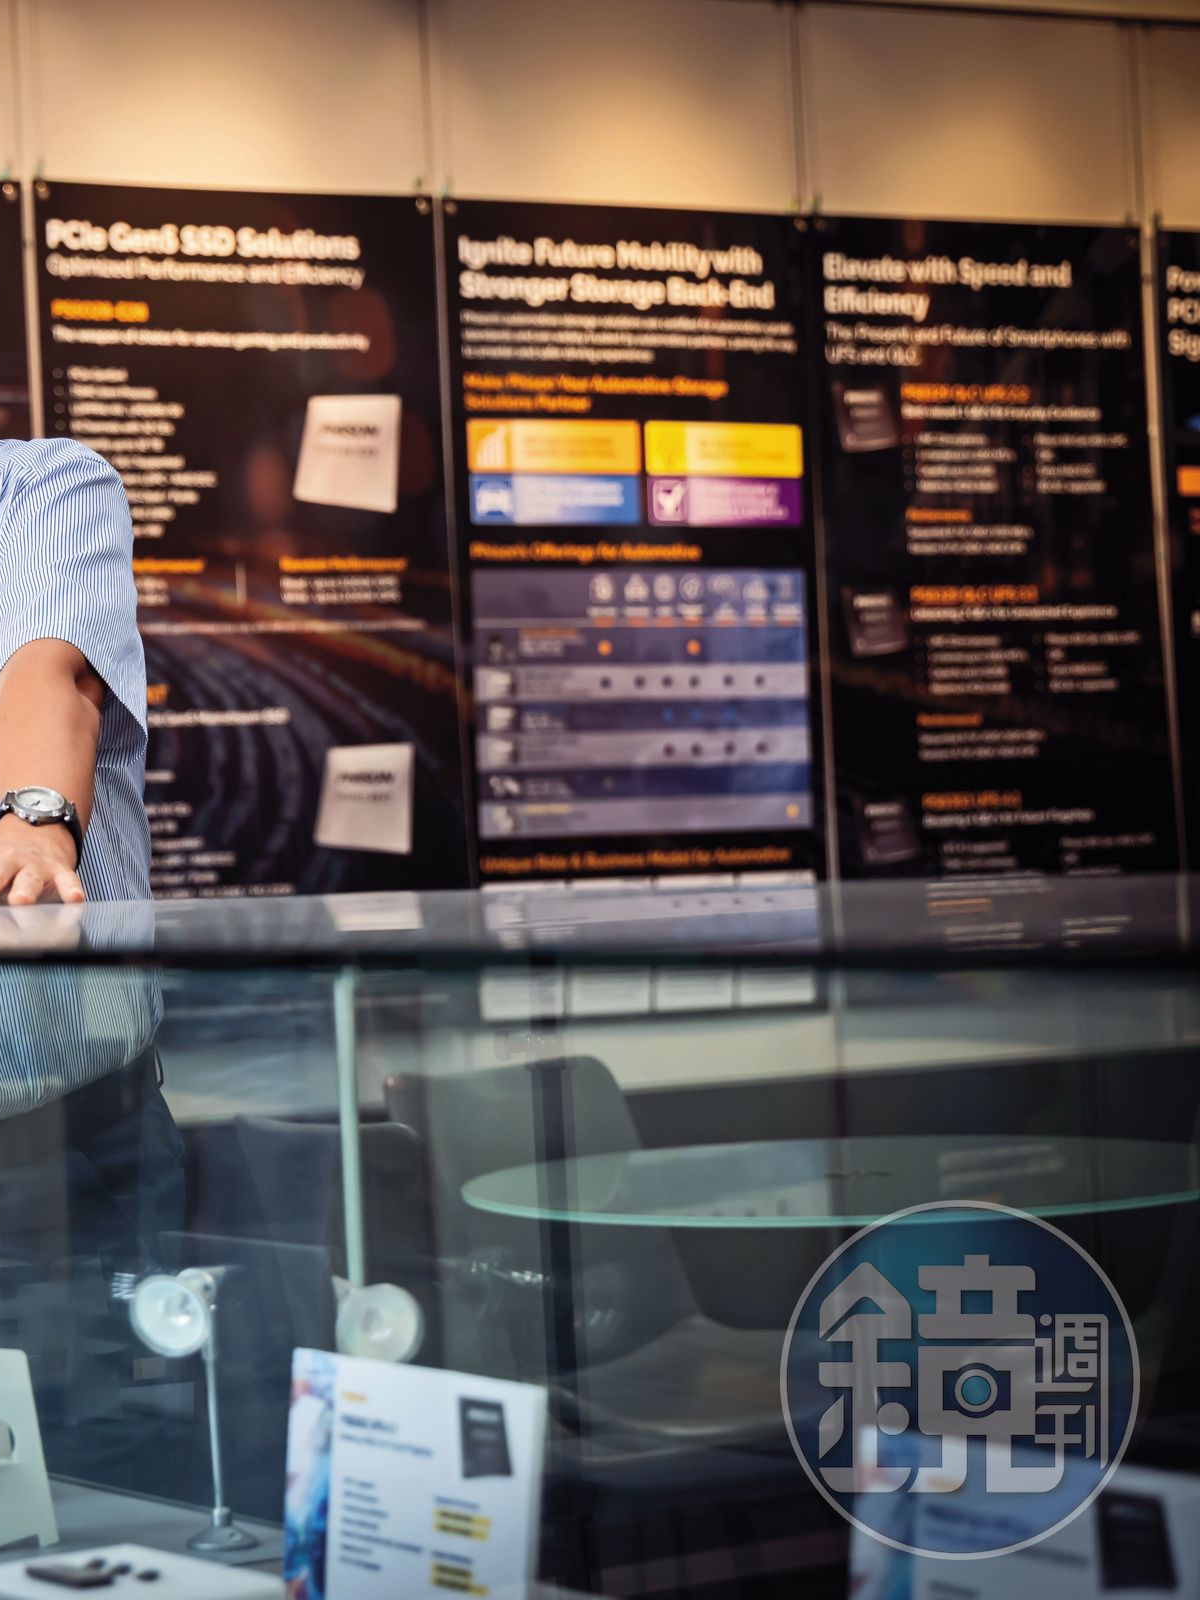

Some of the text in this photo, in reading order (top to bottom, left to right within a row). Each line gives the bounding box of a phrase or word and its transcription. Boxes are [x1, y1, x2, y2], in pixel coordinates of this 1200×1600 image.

[47, 219, 107, 251] PCIe
[181, 225, 235, 256] SSD
[237, 227, 359, 260] Solutions
[460, 235, 761, 278] Ignite Future Mobility with
[461, 271, 569, 305] Stronger
[572, 274, 664, 310] Storage
[825, 253, 1070, 290] Elevate with Speed and
[826, 287, 928, 321] Efficiency
